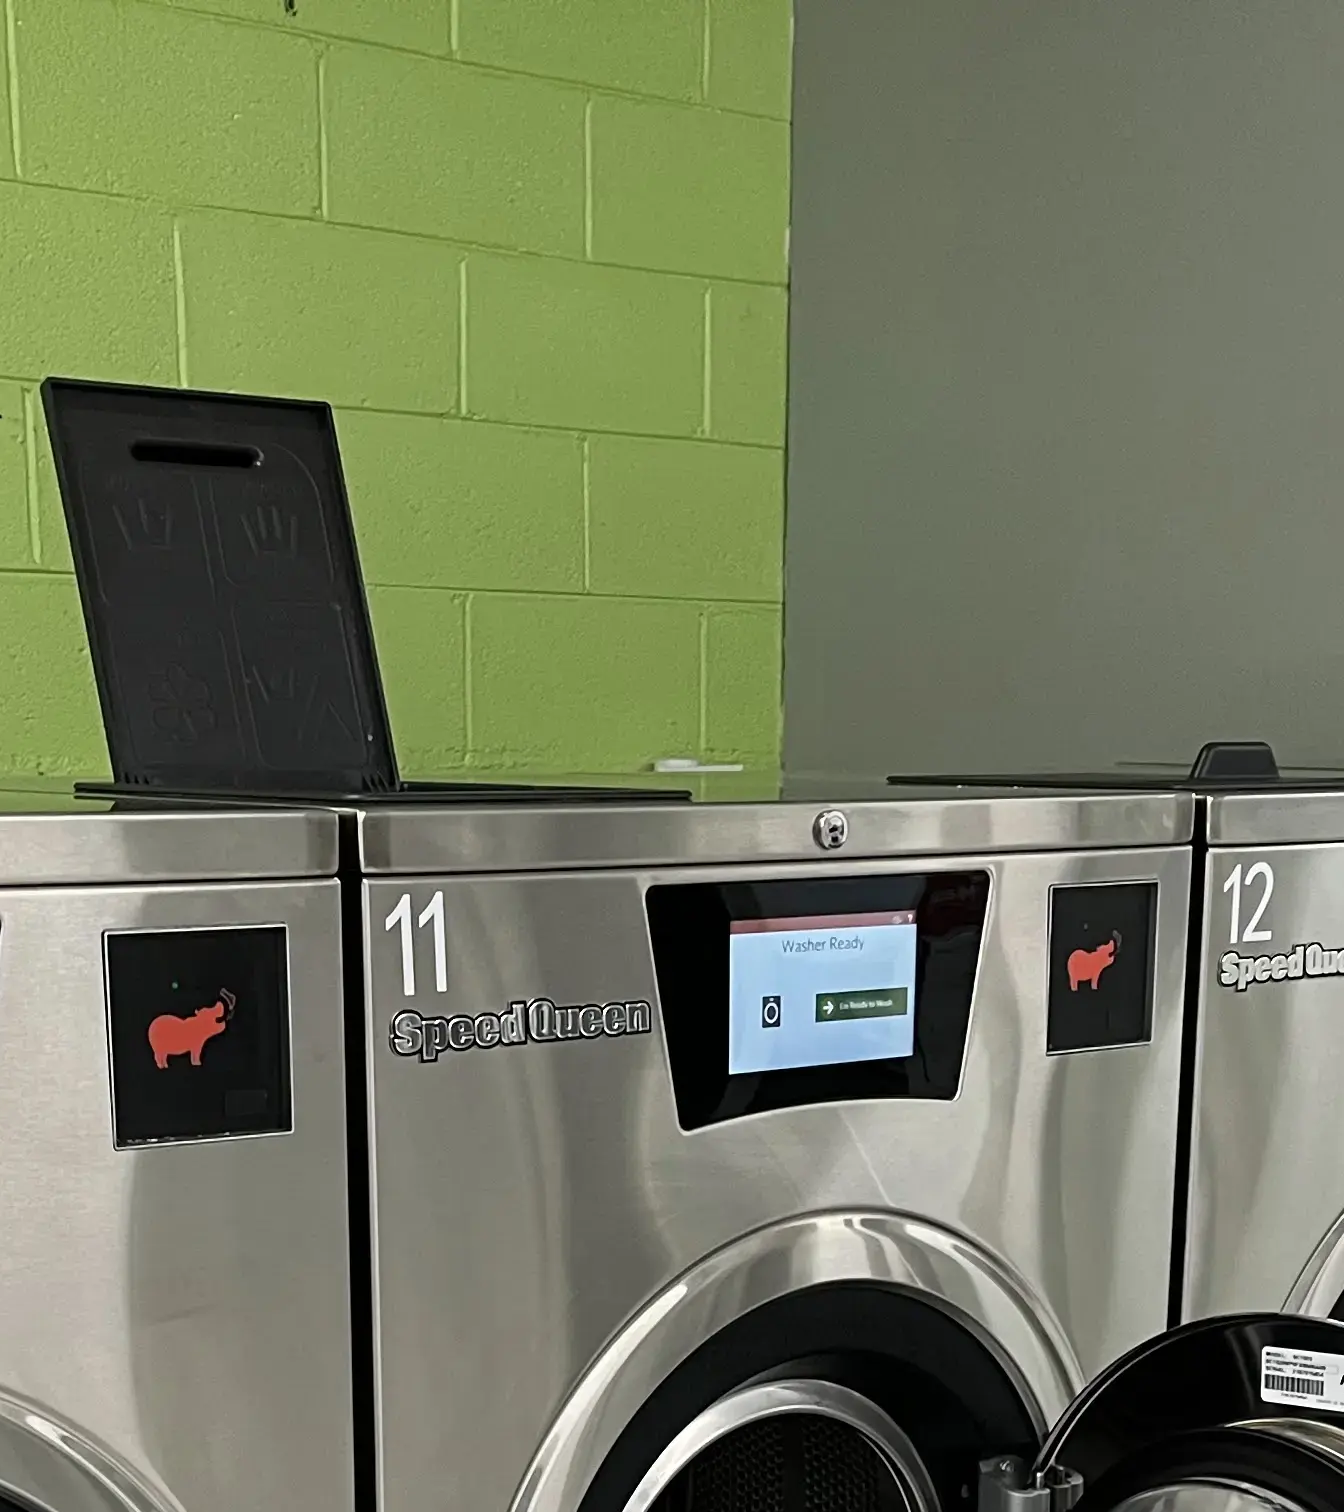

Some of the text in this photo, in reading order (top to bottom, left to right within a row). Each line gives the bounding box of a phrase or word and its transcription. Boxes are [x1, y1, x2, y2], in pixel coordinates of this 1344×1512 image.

[1222, 861, 1274, 944] 12
[385, 890, 448, 996] 11
[782, 935, 865, 953] Washer Ready
[1217, 943, 1305, 992] Speed
[389, 997, 652, 1063] Speed Queen
